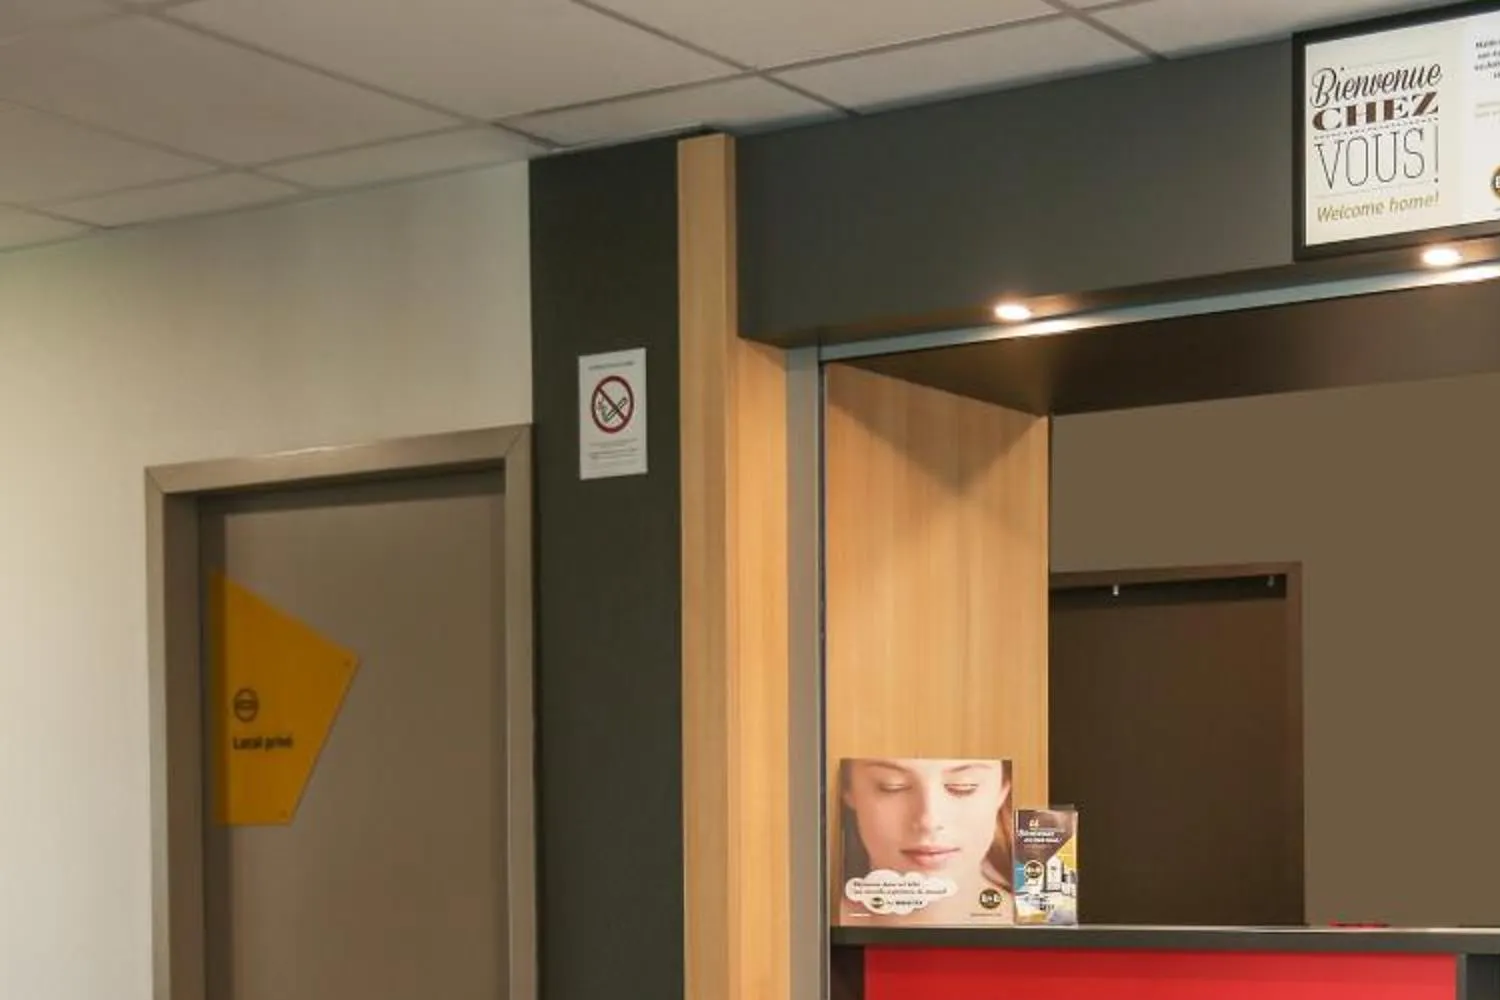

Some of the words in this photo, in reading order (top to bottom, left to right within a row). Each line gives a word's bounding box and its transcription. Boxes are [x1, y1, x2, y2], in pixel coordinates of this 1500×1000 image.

[1310, 64, 1442, 108] Bienvenue
[1312, 92, 1439, 130] CHEZ
[1317, 203, 1385, 222] Welcome
[1389, 192, 1440, 213] home!
